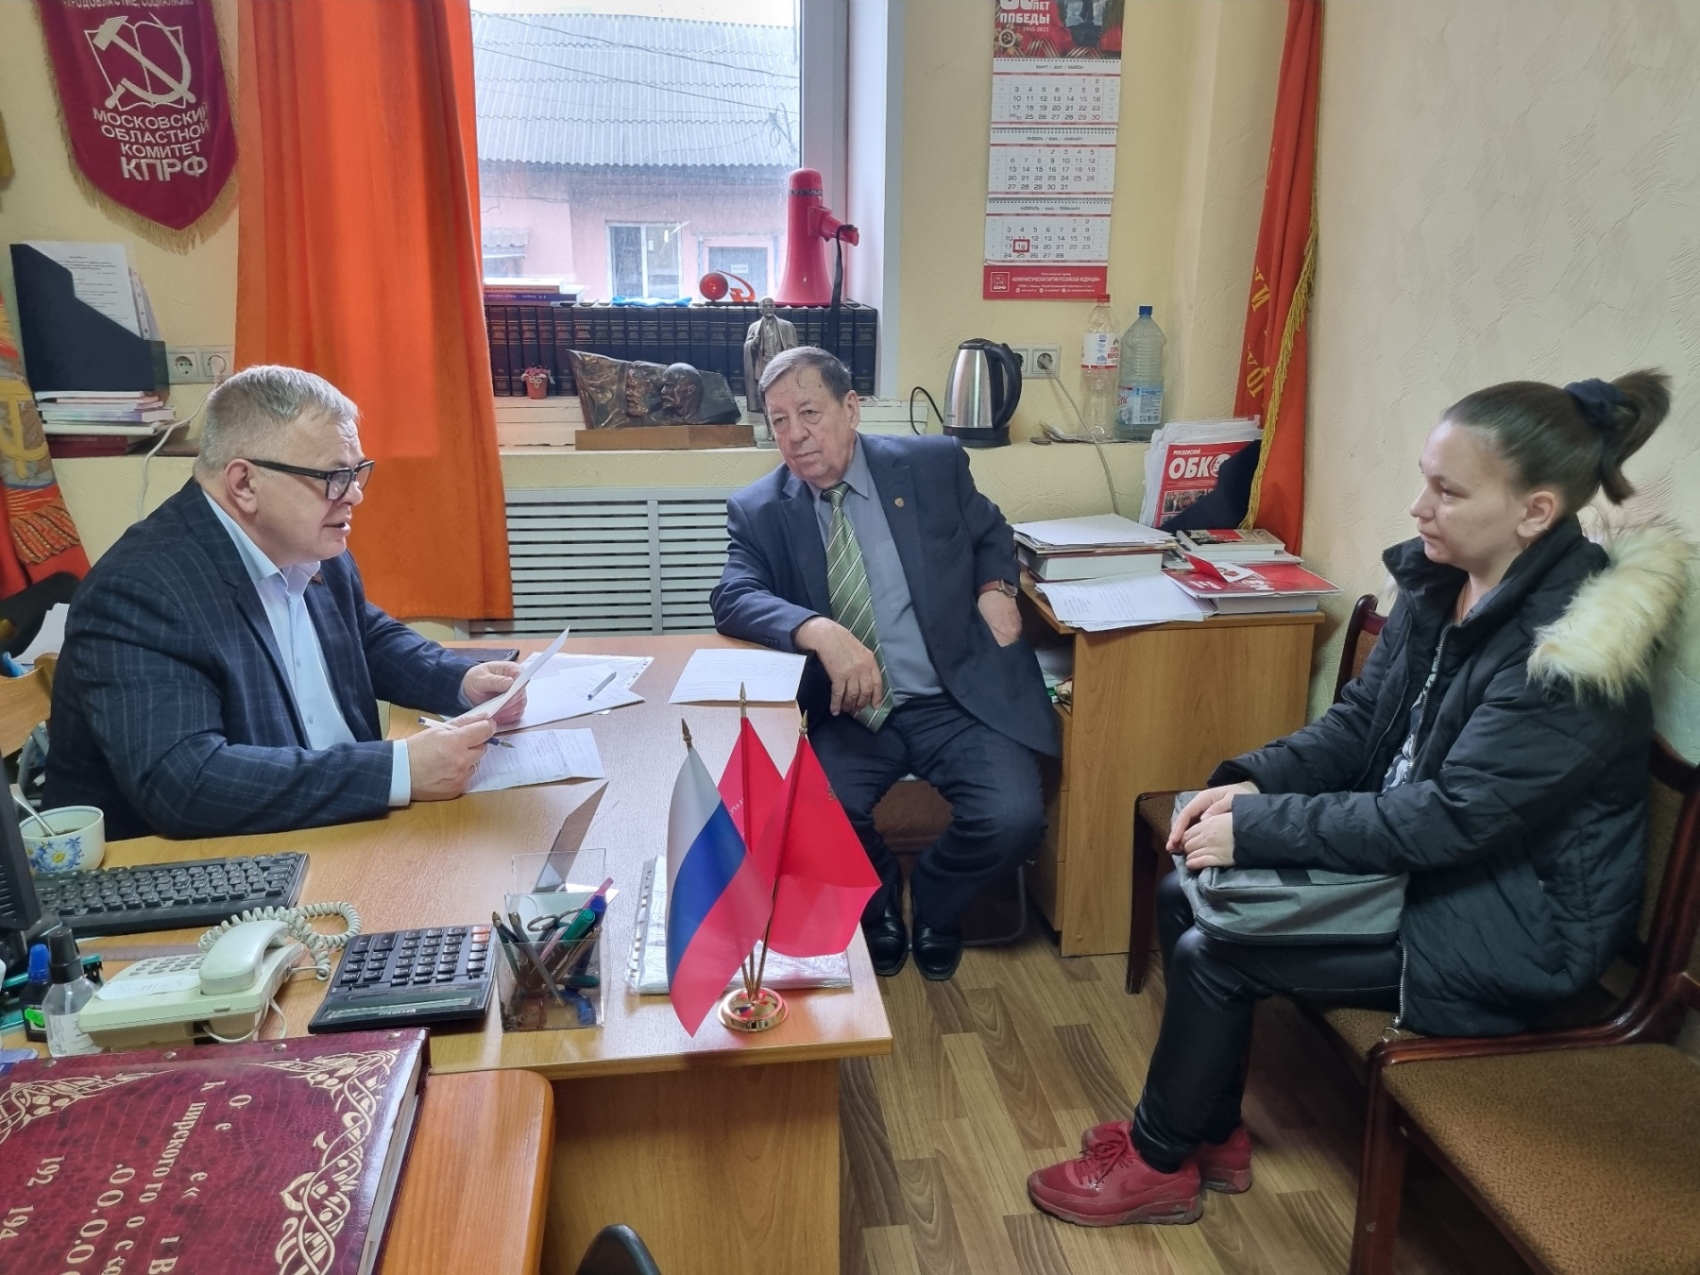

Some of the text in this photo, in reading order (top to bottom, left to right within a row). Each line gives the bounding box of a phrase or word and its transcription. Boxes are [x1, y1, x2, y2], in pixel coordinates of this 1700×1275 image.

[1033, 2, 1050, 10] ЛЕТ
[1000, 13, 1050, 25] ПОБЕДЫ
[93, 102, 208, 129] МОСКОВСКИЙ
[101, 119, 209, 143] ОБЛАСТНОЙ
[120, 139, 202, 158] КОМИТЕТ
[120, 156, 208, 181] КПРФ
